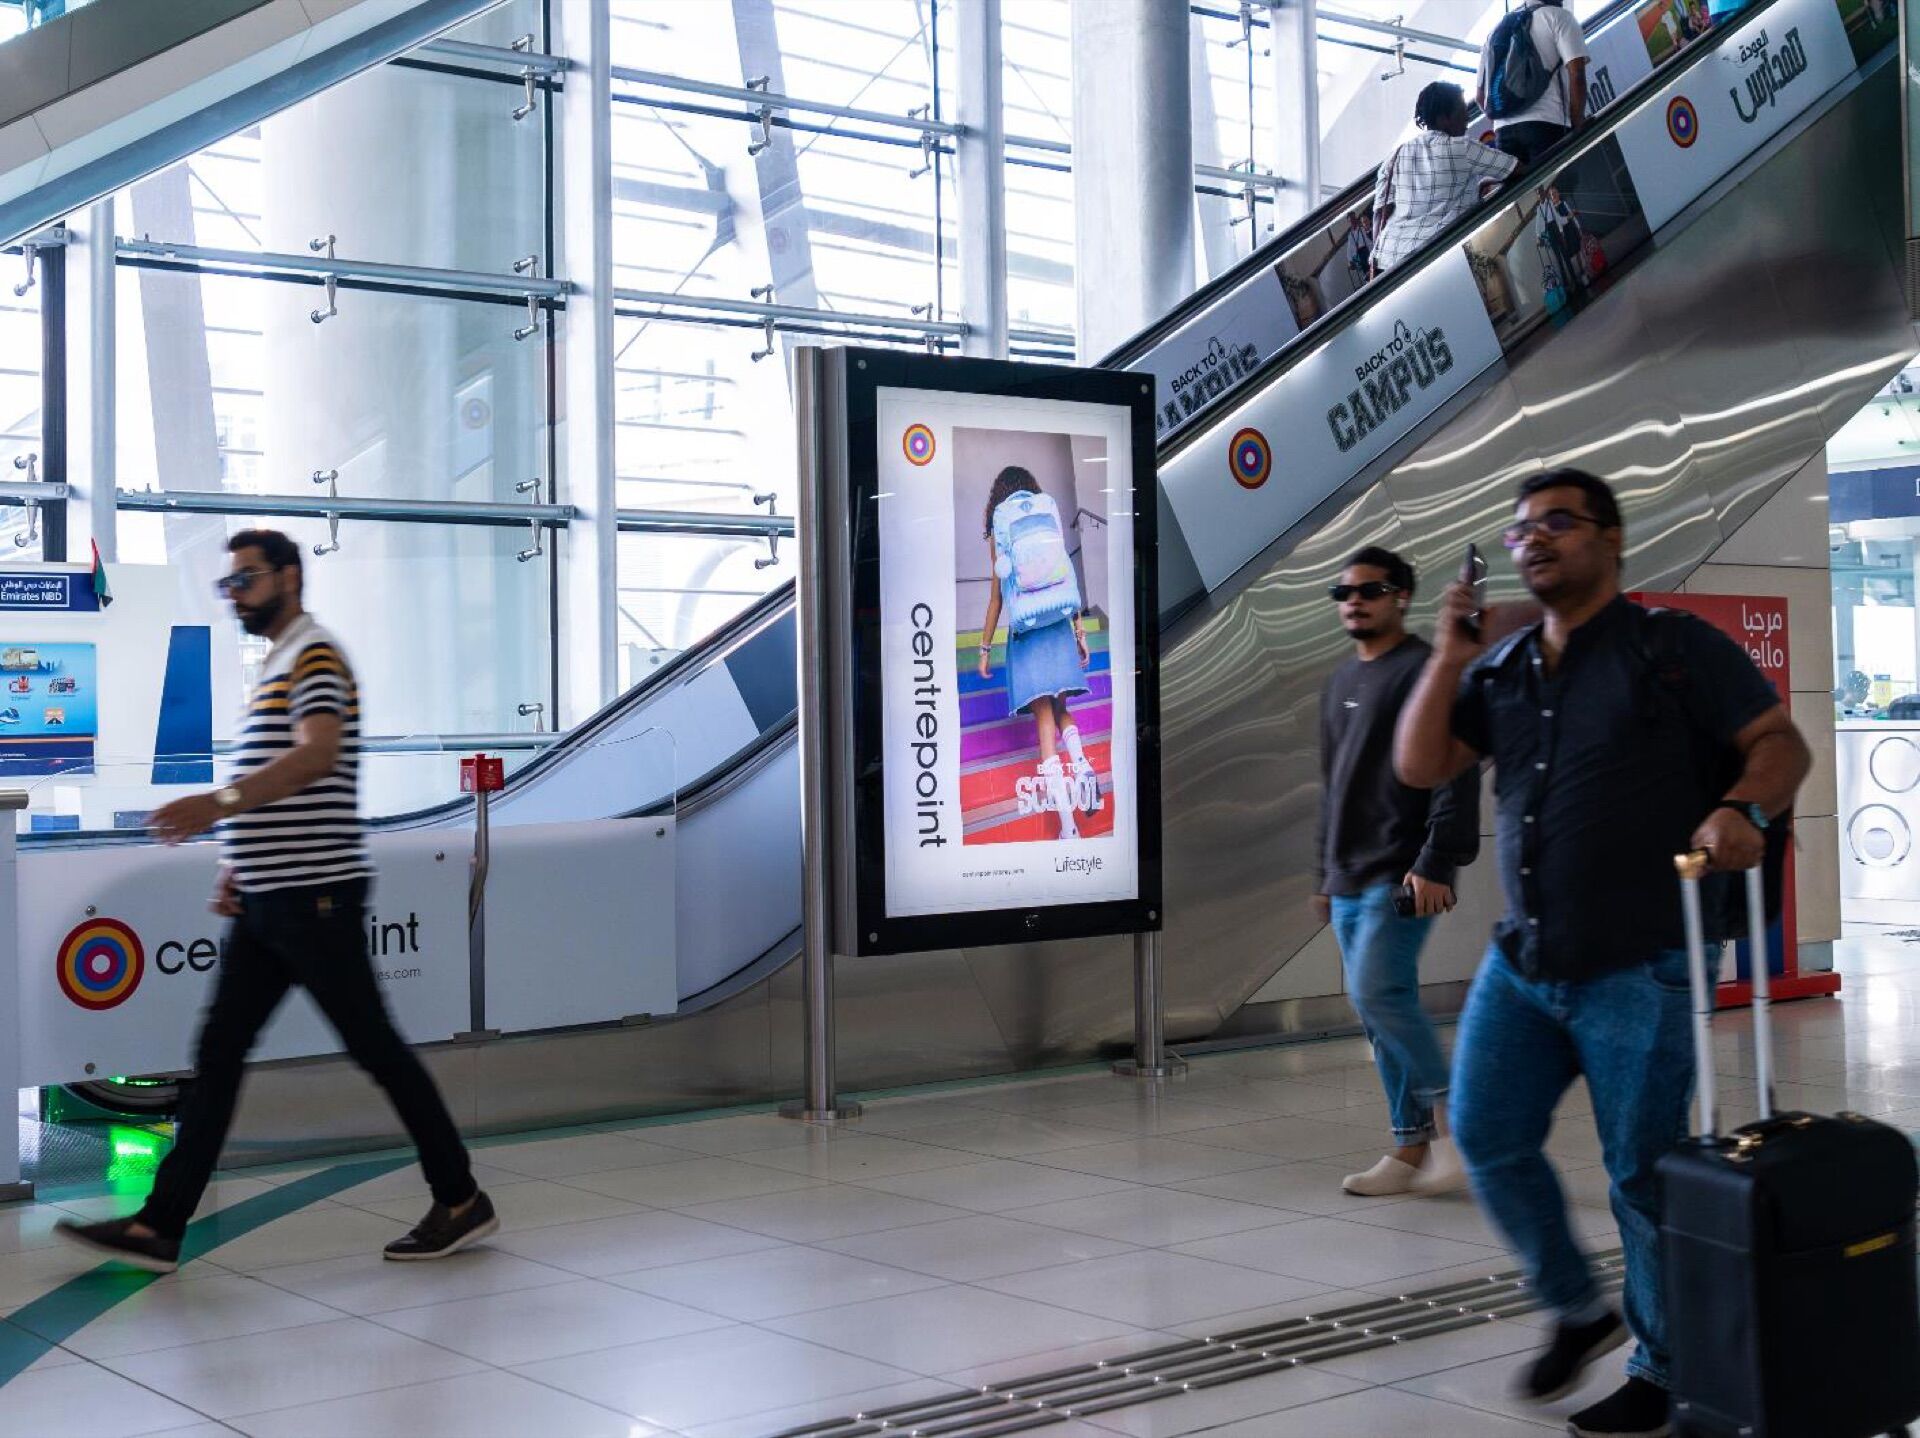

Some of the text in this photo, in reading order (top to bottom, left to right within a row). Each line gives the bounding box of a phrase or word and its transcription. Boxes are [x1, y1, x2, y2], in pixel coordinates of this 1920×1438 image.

[1738, 28, 1770, 63] العودة
[1171, 352, 1218, 394] BACK TO
[1354, 337, 1404, 382] BACK TO
[1326, 326, 1454, 453] CAMPUS
[0, 591, 62, 601] Emirates NBD
[1742, 603, 1782, 638] مرحبا
[910, 602, 947, 848] centrepoint
[1054, 855, 1103, 876] Lifestyle
